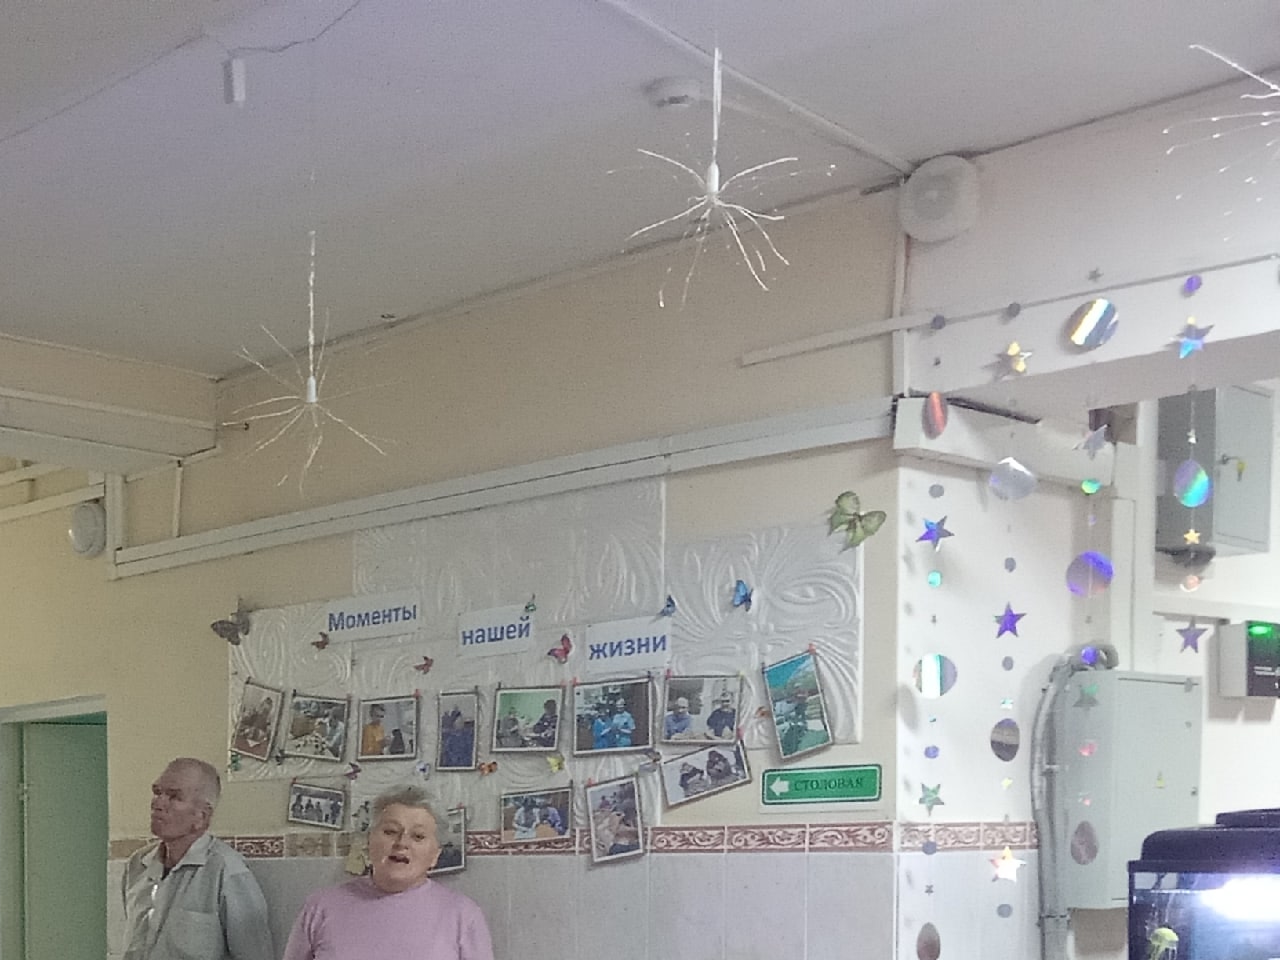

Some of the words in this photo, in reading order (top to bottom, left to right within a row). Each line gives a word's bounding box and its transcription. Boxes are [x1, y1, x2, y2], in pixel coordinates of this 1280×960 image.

[328, 604, 417, 632] Моменты
[461, 614, 531, 646] нашей
[588, 633, 667, 661] жизни
[794, 777, 864, 792] СТОЛОВАЯ
